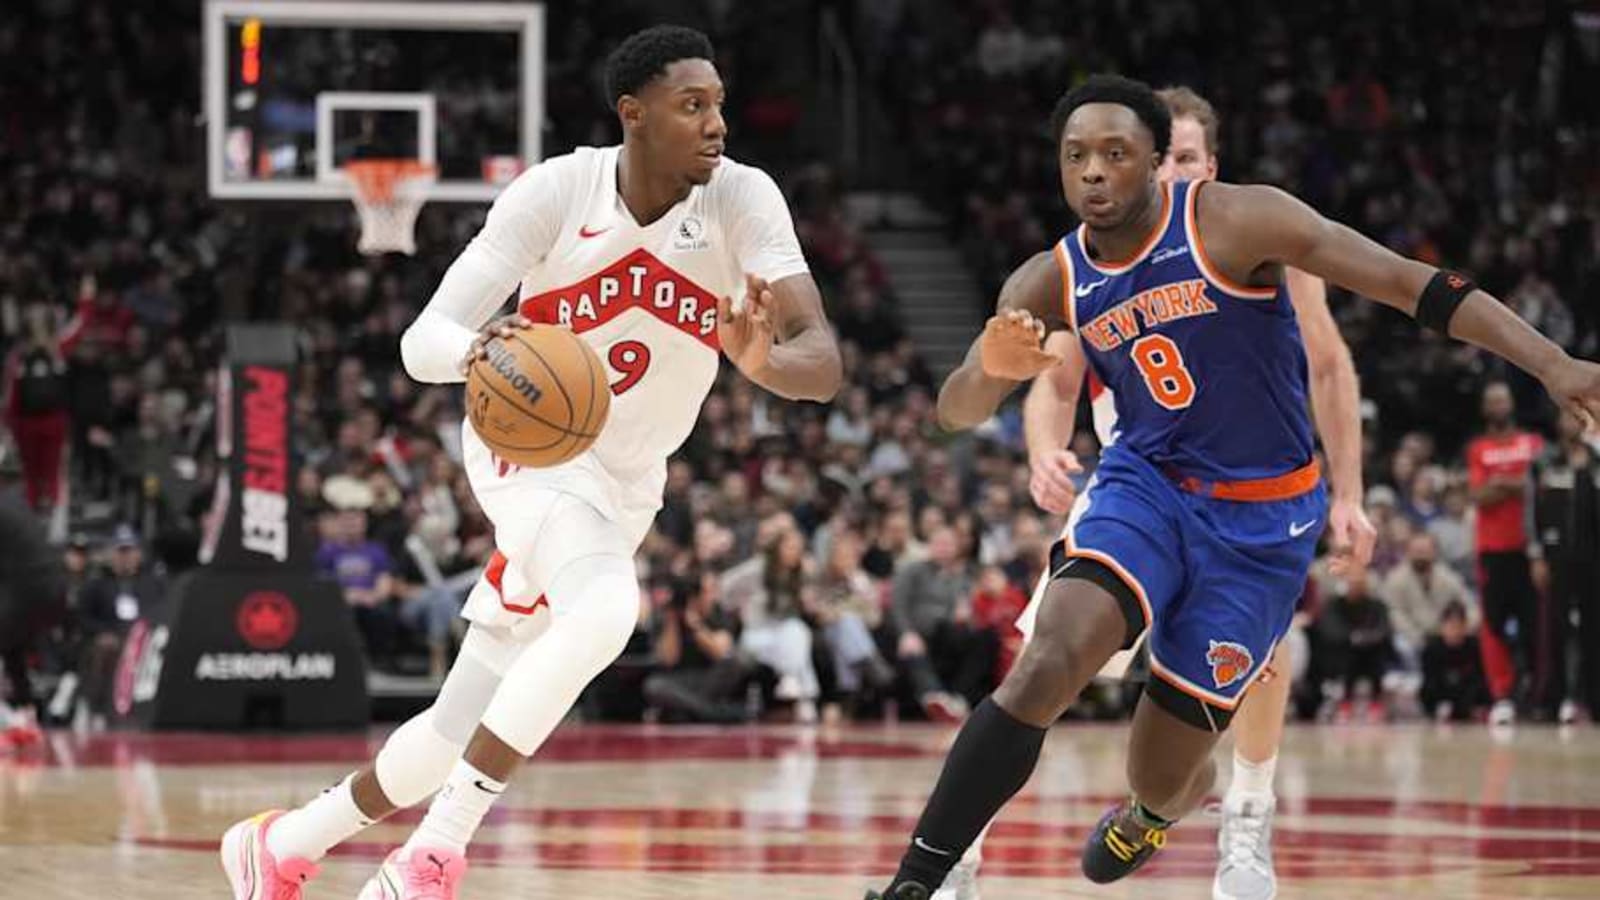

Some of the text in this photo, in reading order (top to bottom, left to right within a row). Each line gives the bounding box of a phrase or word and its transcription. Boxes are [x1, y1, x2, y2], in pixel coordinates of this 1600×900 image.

[558, 265, 718, 335] RAPTORS
[1080, 279, 1218, 352] NEW YORK
[608, 340, 651, 397] 9
[1130, 333, 1196, 410] 8
[196, 653, 335, 681] AEROPLAN
